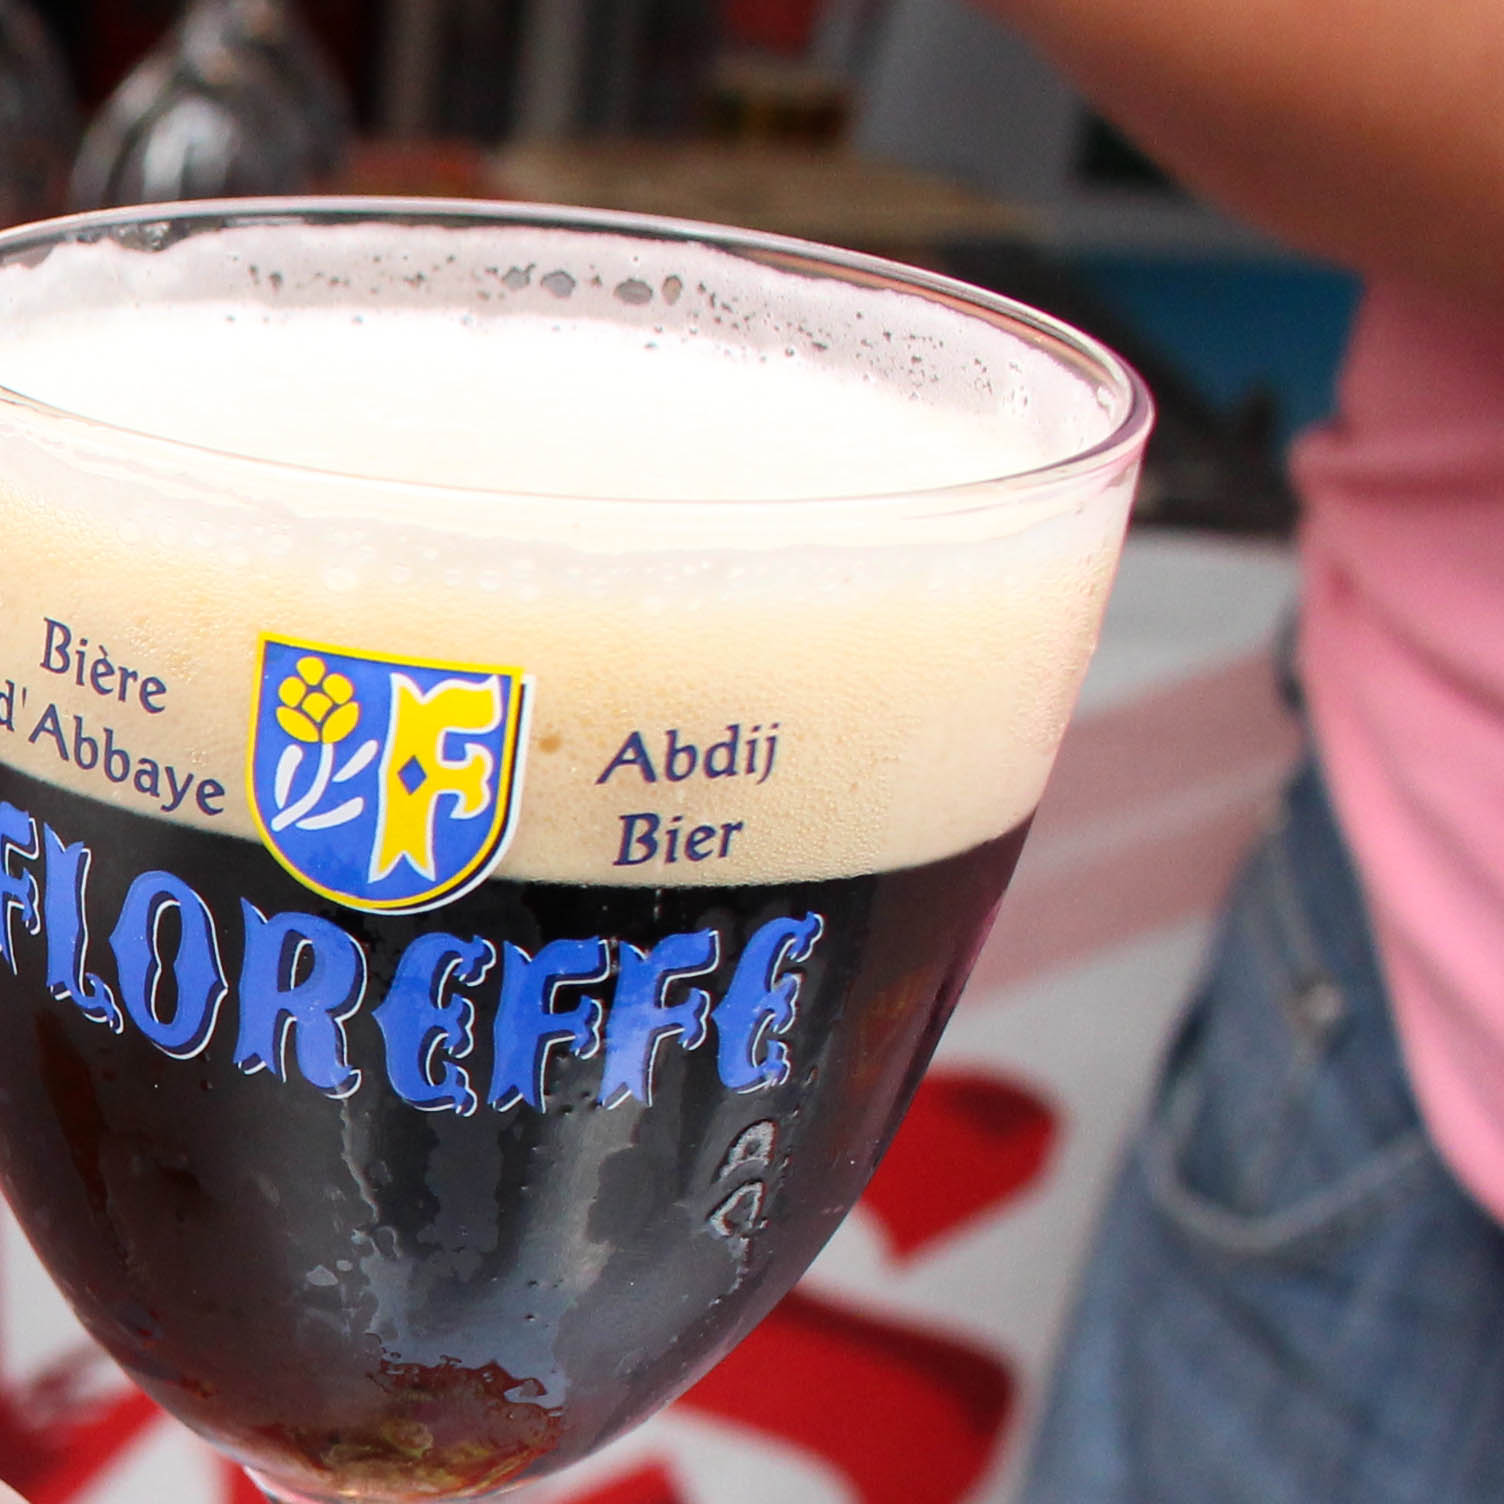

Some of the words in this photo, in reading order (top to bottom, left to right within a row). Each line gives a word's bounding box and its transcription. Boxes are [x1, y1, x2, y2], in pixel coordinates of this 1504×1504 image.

[40, 616, 169, 713] Bière
[596, 722, 781, 785] Abdij
[612, 812, 745, 867] Bier
